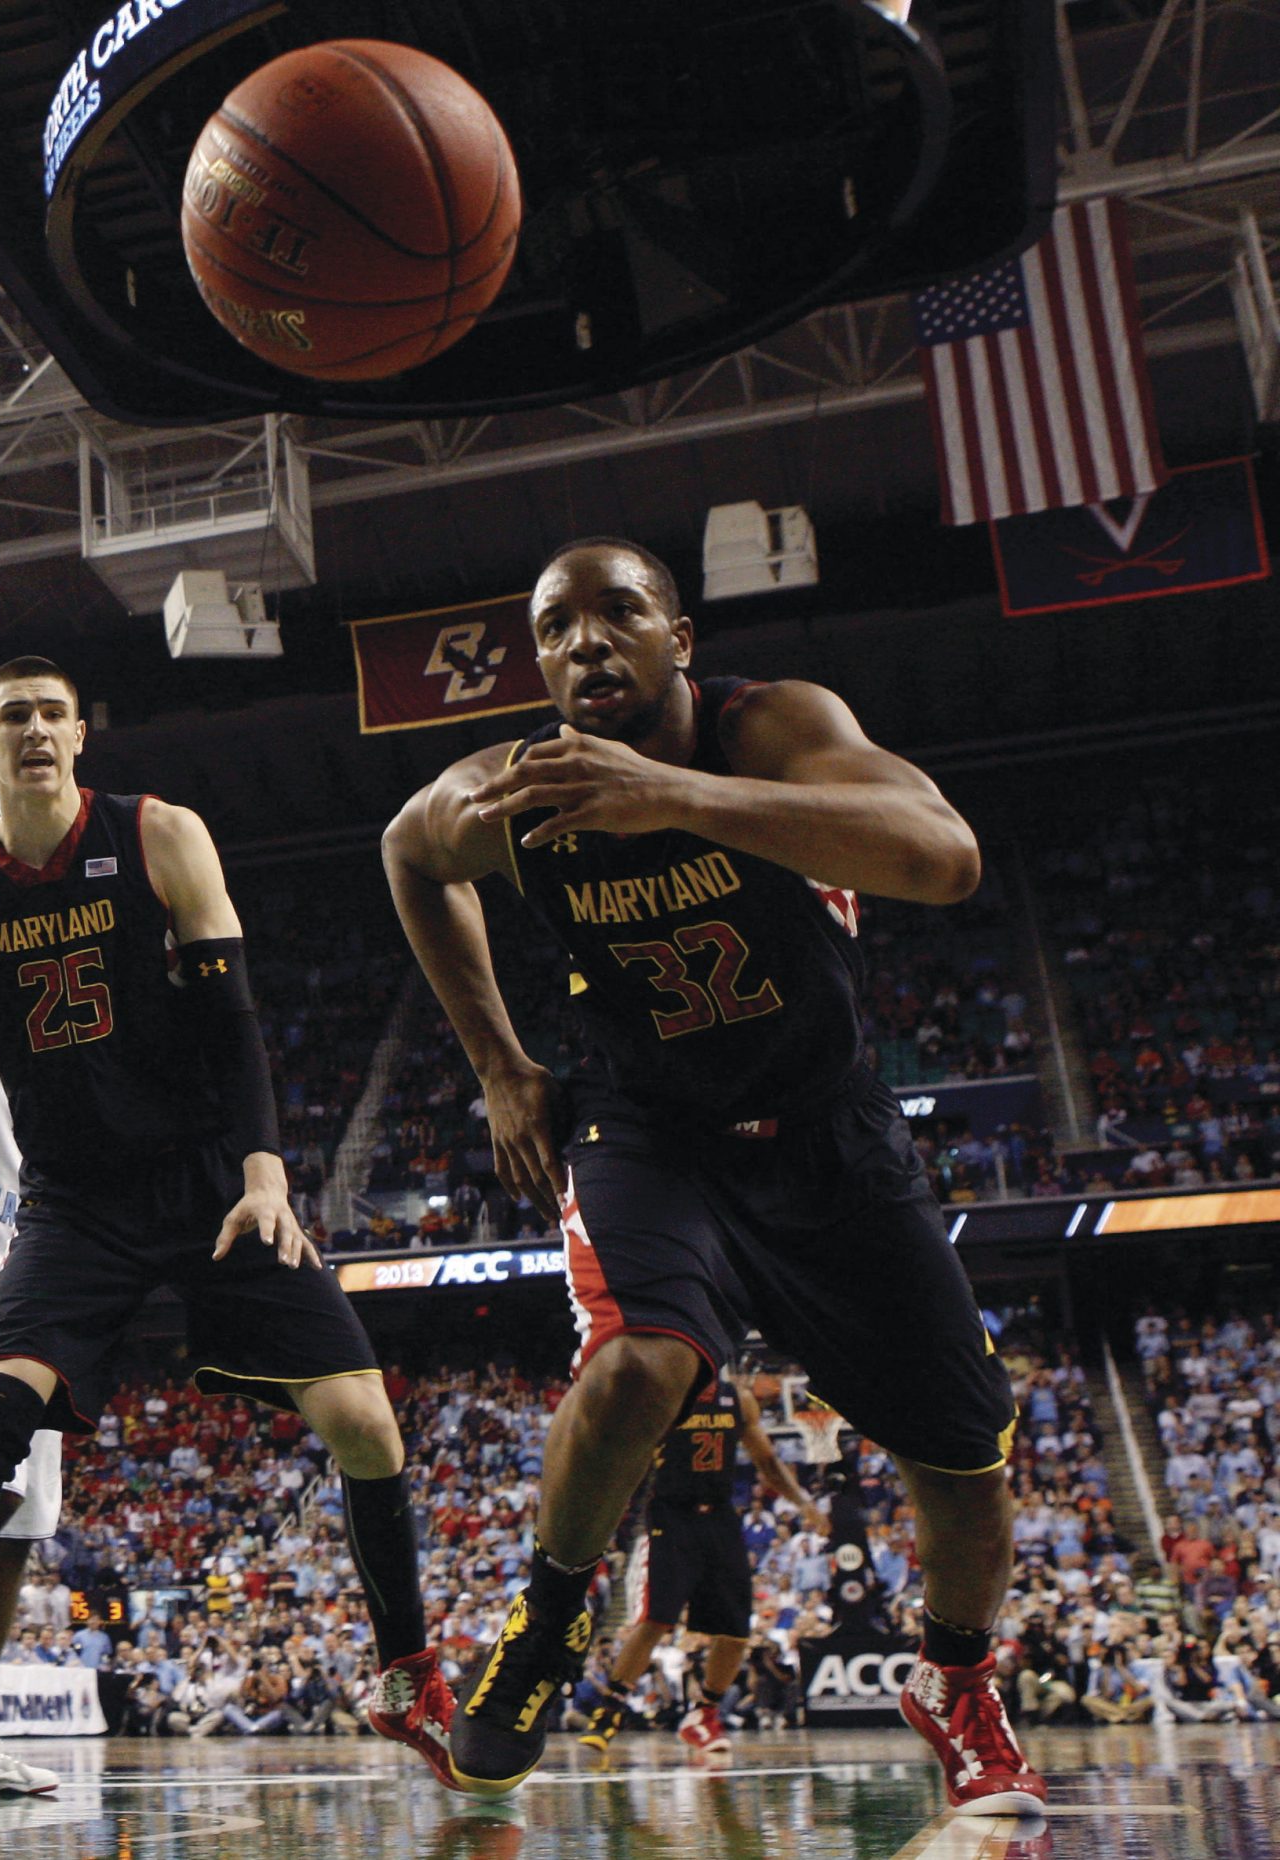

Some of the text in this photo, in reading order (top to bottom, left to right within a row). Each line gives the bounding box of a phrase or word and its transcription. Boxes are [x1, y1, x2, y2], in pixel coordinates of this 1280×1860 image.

[43, 48, 88, 162] ORTH
[564, 851, 742, 924] MARYLAND
[17, 947, 113, 1053] 25
[608, 921, 783, 1040] 32
[375, 1250, 567, 1286] 2013 ACC BAS
[691, 1431, 724, 1472] 21
[108, 1601, 123, 1620] 3
[806, 1652, 919, 1696] ACC
